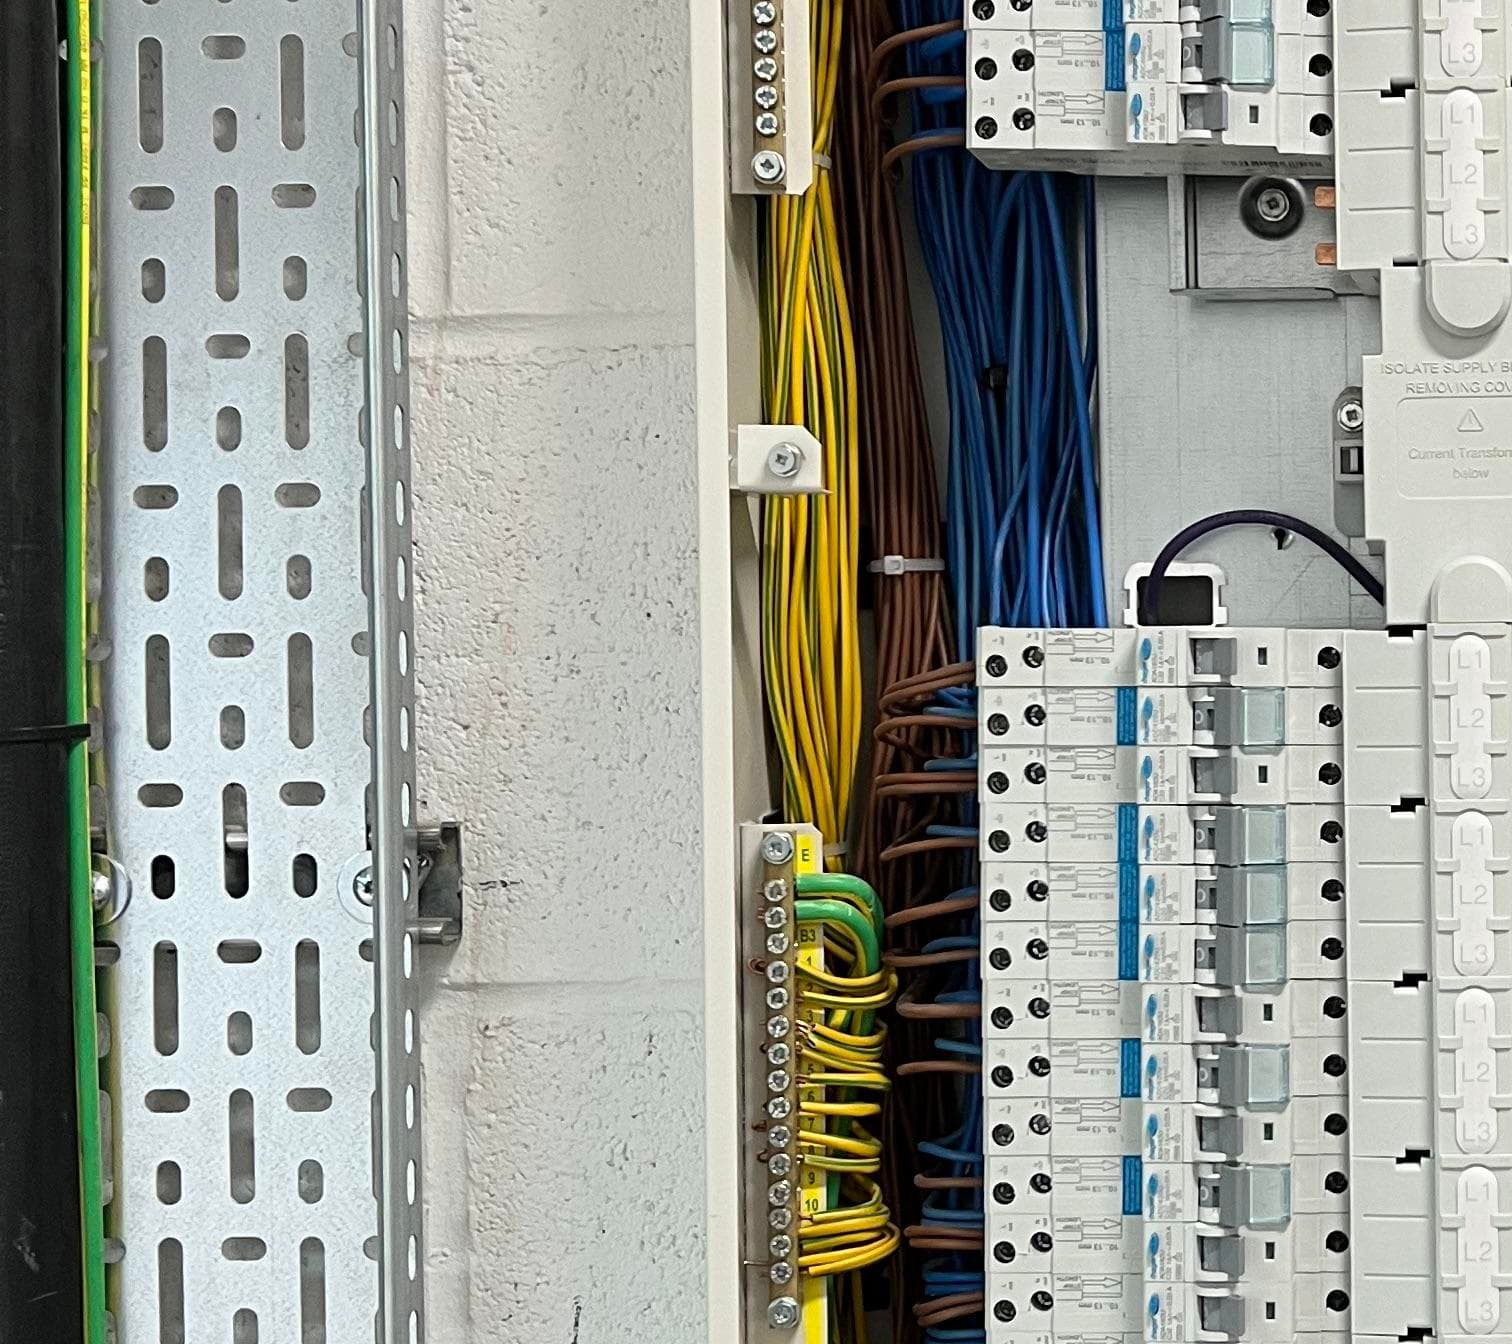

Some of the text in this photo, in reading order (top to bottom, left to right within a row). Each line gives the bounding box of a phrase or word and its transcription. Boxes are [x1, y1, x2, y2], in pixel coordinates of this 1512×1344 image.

[1448, 43, 1476, 64] L3
[1450, 103, 1474, 124] L1
[1449, 163, 1477, 184] L2
[1450, 224, 1478, 245] L3
[1381, 362, 1439, 374] ISOLATE
[1443, 361, 1496, 374] SUPPLY
[1406, 382, 1479, 394] REMOVING
[1408, 447, 1454, 459] Current
[1453, 467, 1489, 479] below
[1457, 649, 1482, 669] L1
[1457, 707, 1485, 728] L2
[1458, 767, 1486, 787] L3
[1459, 825, 1484, 846] L1
[802, 849, 809, 861] E
[1459, 884, 1488, 905] L2
[800, 929, 816, 942] B3
[1460, 943, 1488, 963] L3
[1463, 1002, 1487, 1024] L1
[1462, 1062, 1490, 1082] L2
[808, 1118, 815, 1130] 7
[1463, 1121, 1490, 1142] L3
[808, 1172, 815, 1184] 9
[1465, 1181, 1490, 1202] L1
[805, 1199, 818, 1212] 10
[1464, 1240, 1493, 1262] L2
[1465, 1300, 1493, 1322] L3
